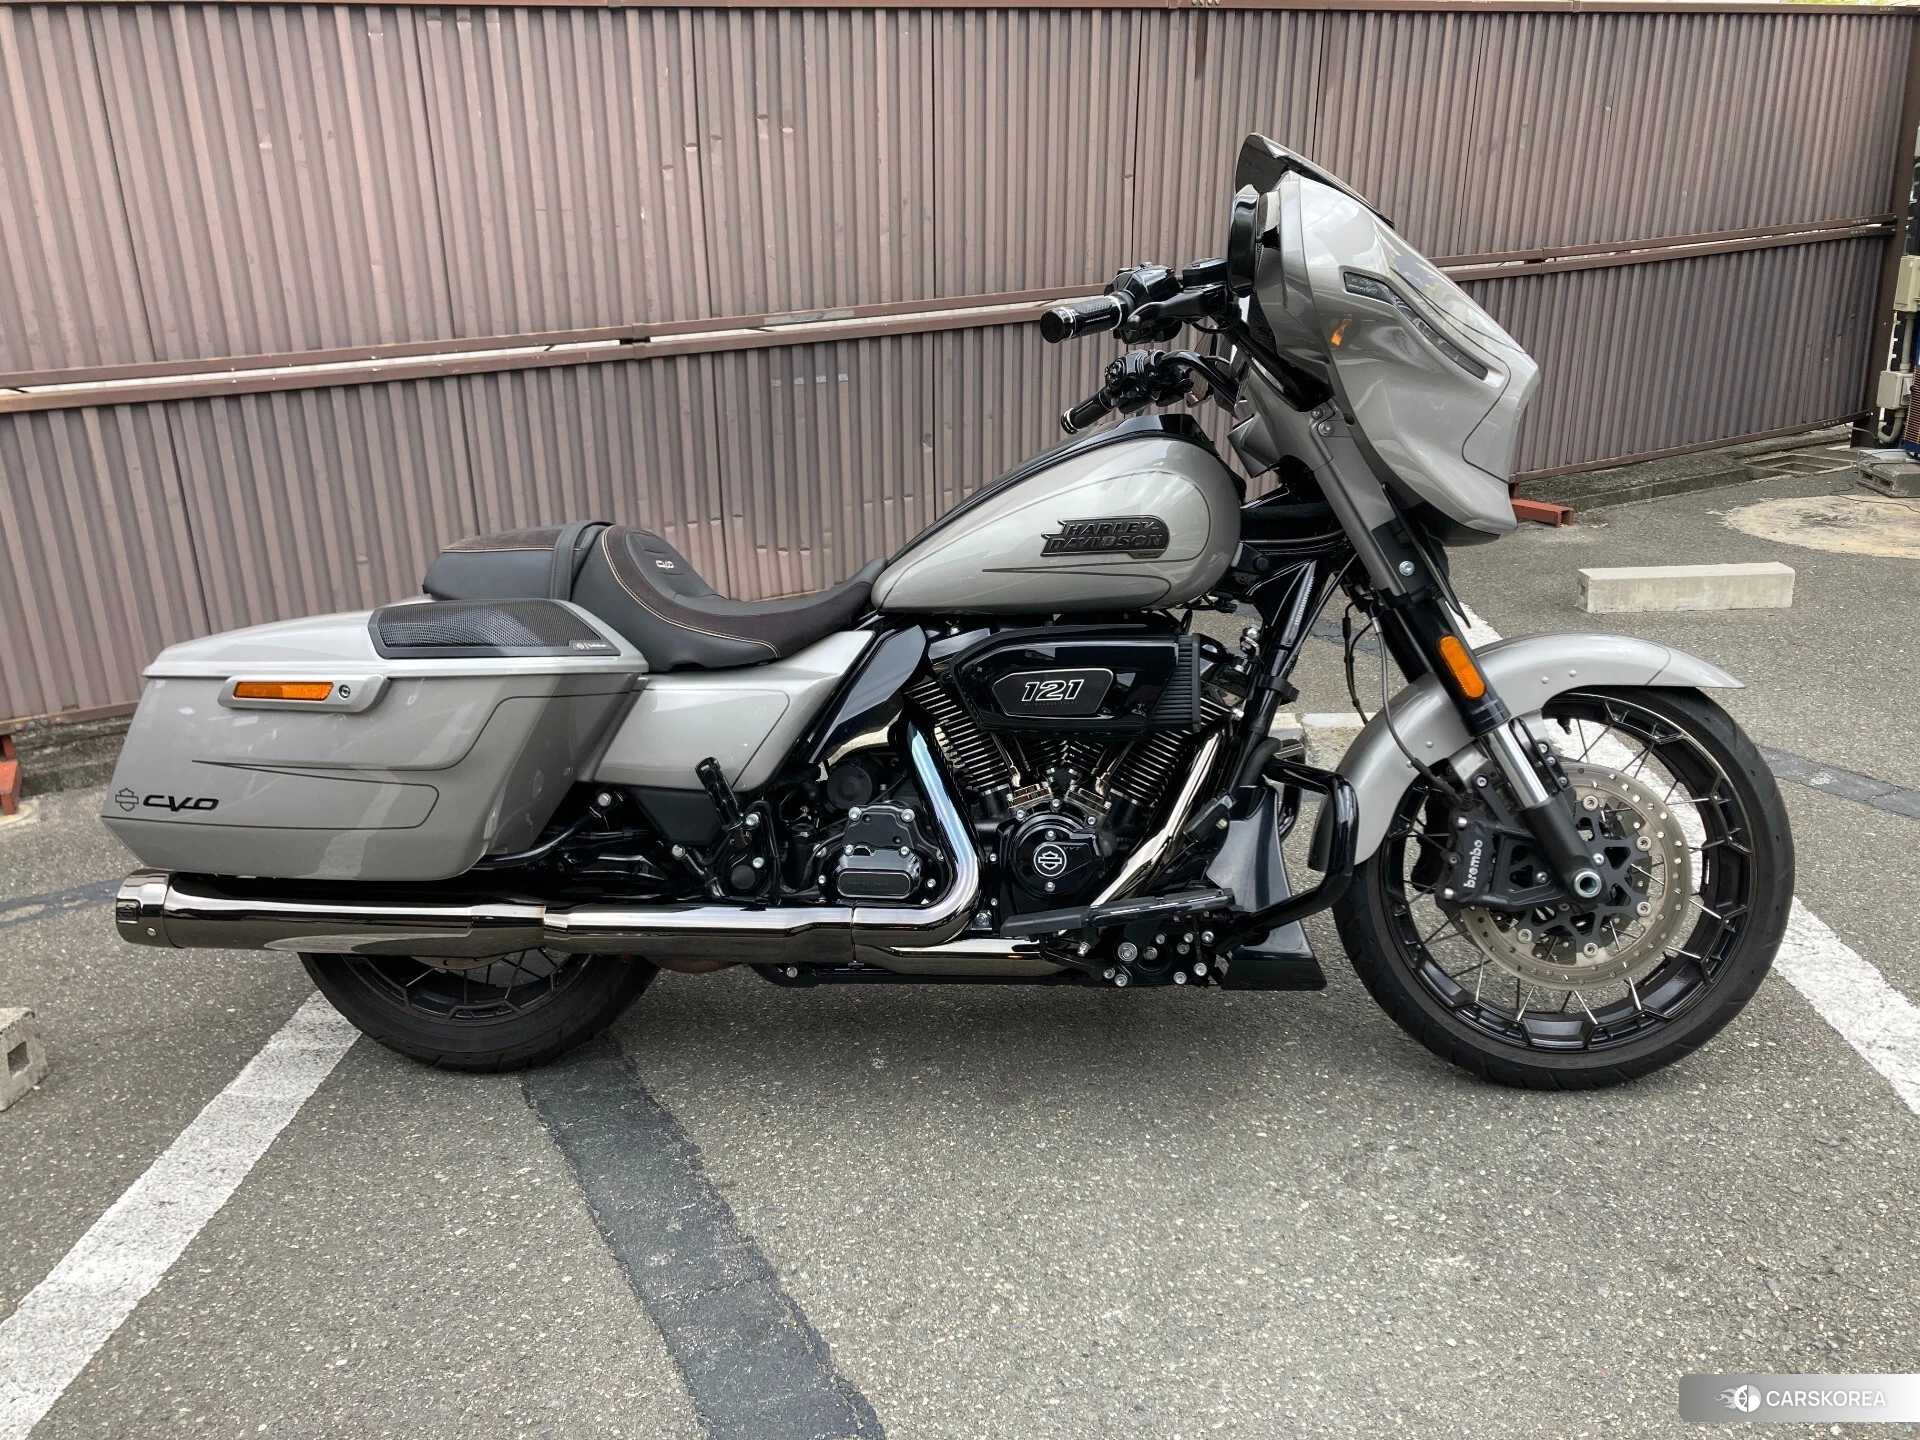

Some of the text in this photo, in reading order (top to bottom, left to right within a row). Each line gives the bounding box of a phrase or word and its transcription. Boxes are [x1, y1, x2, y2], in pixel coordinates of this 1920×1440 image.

[1064, 521, 1159, 536] HARLEY-
[1049, 534, 1162, 549] DAVIDSON
[1022, 679, 1084, 701] 121
[143, 795, 219, 812] CVO
[1463, 840, 1483, 888] brembo
